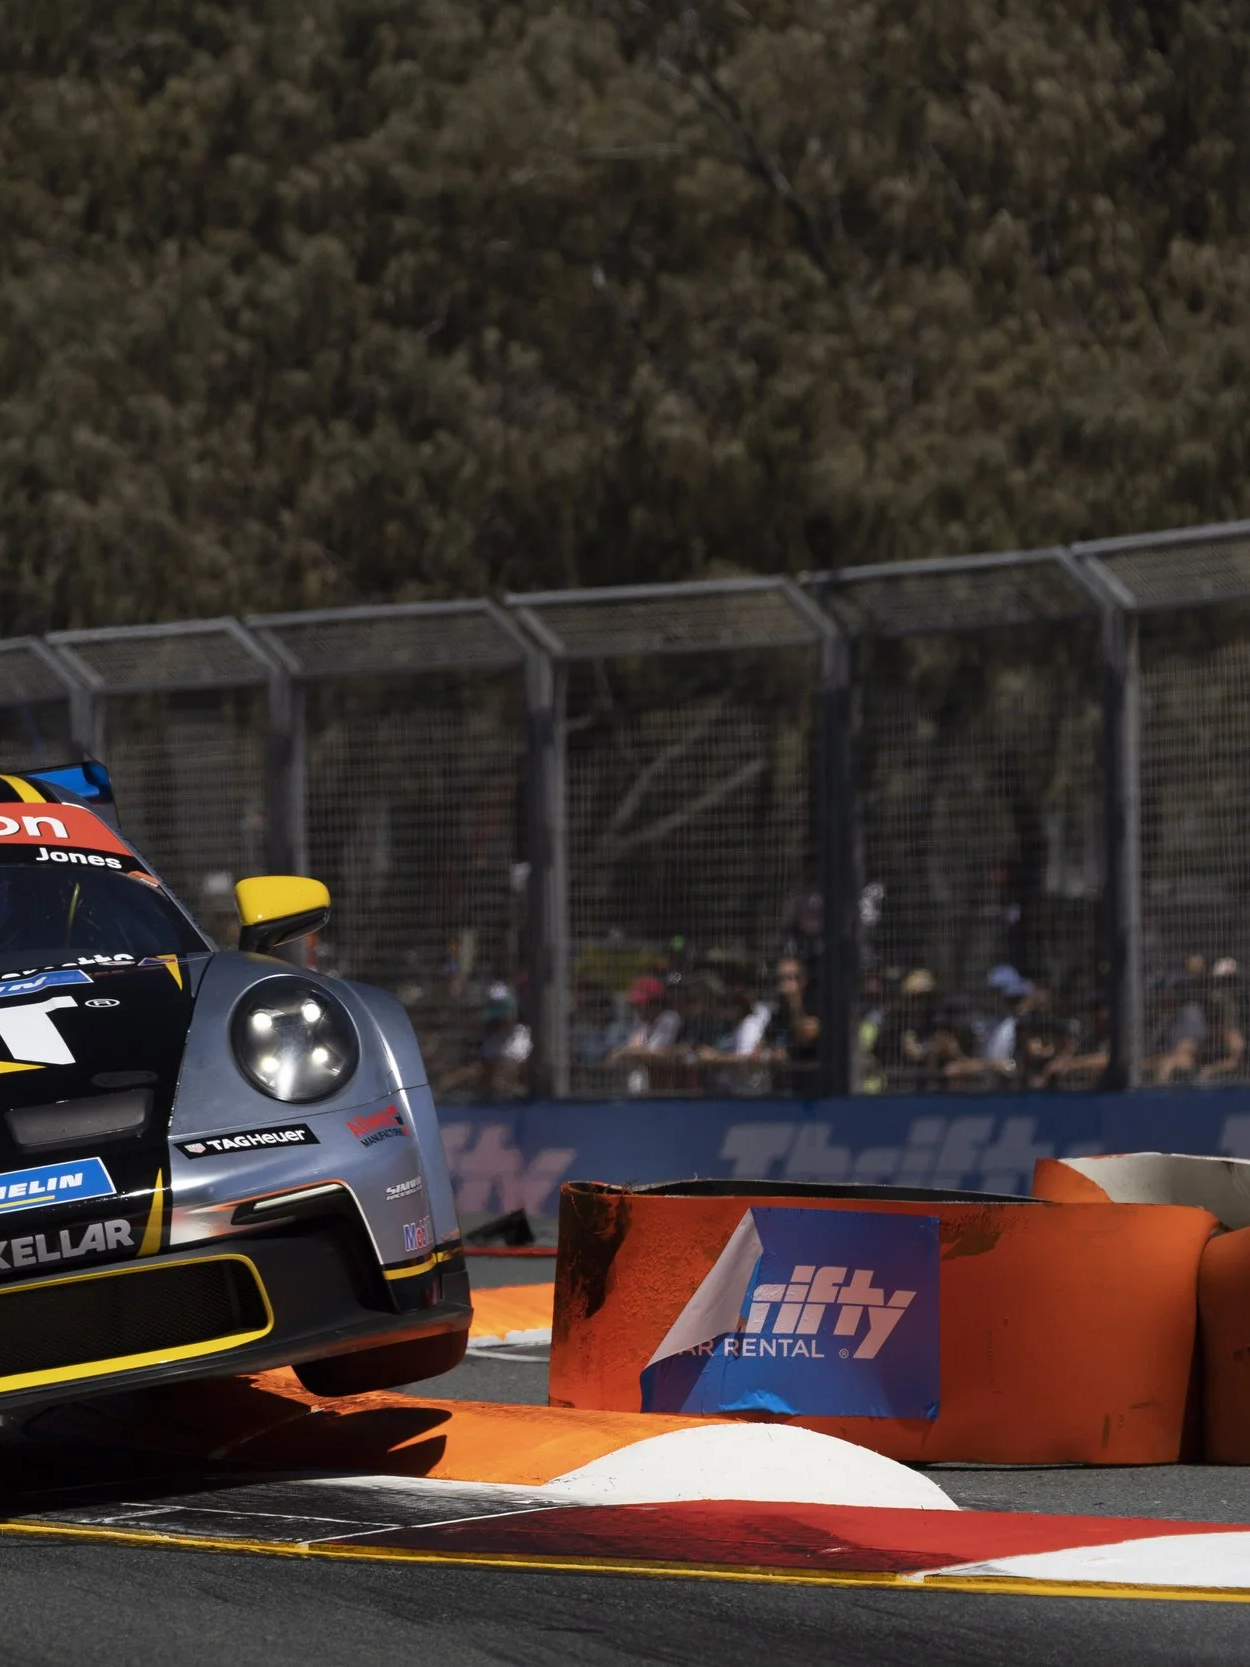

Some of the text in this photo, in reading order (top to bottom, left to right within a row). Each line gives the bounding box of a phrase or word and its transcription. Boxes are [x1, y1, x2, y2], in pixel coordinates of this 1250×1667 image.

[36, 846, 122, 869] Jones
[721, 1115, 1105, 1188] Thrift
[746, 1265, 918, 1359] rifty
[724, 1338, 825, 1358] RENTAL
